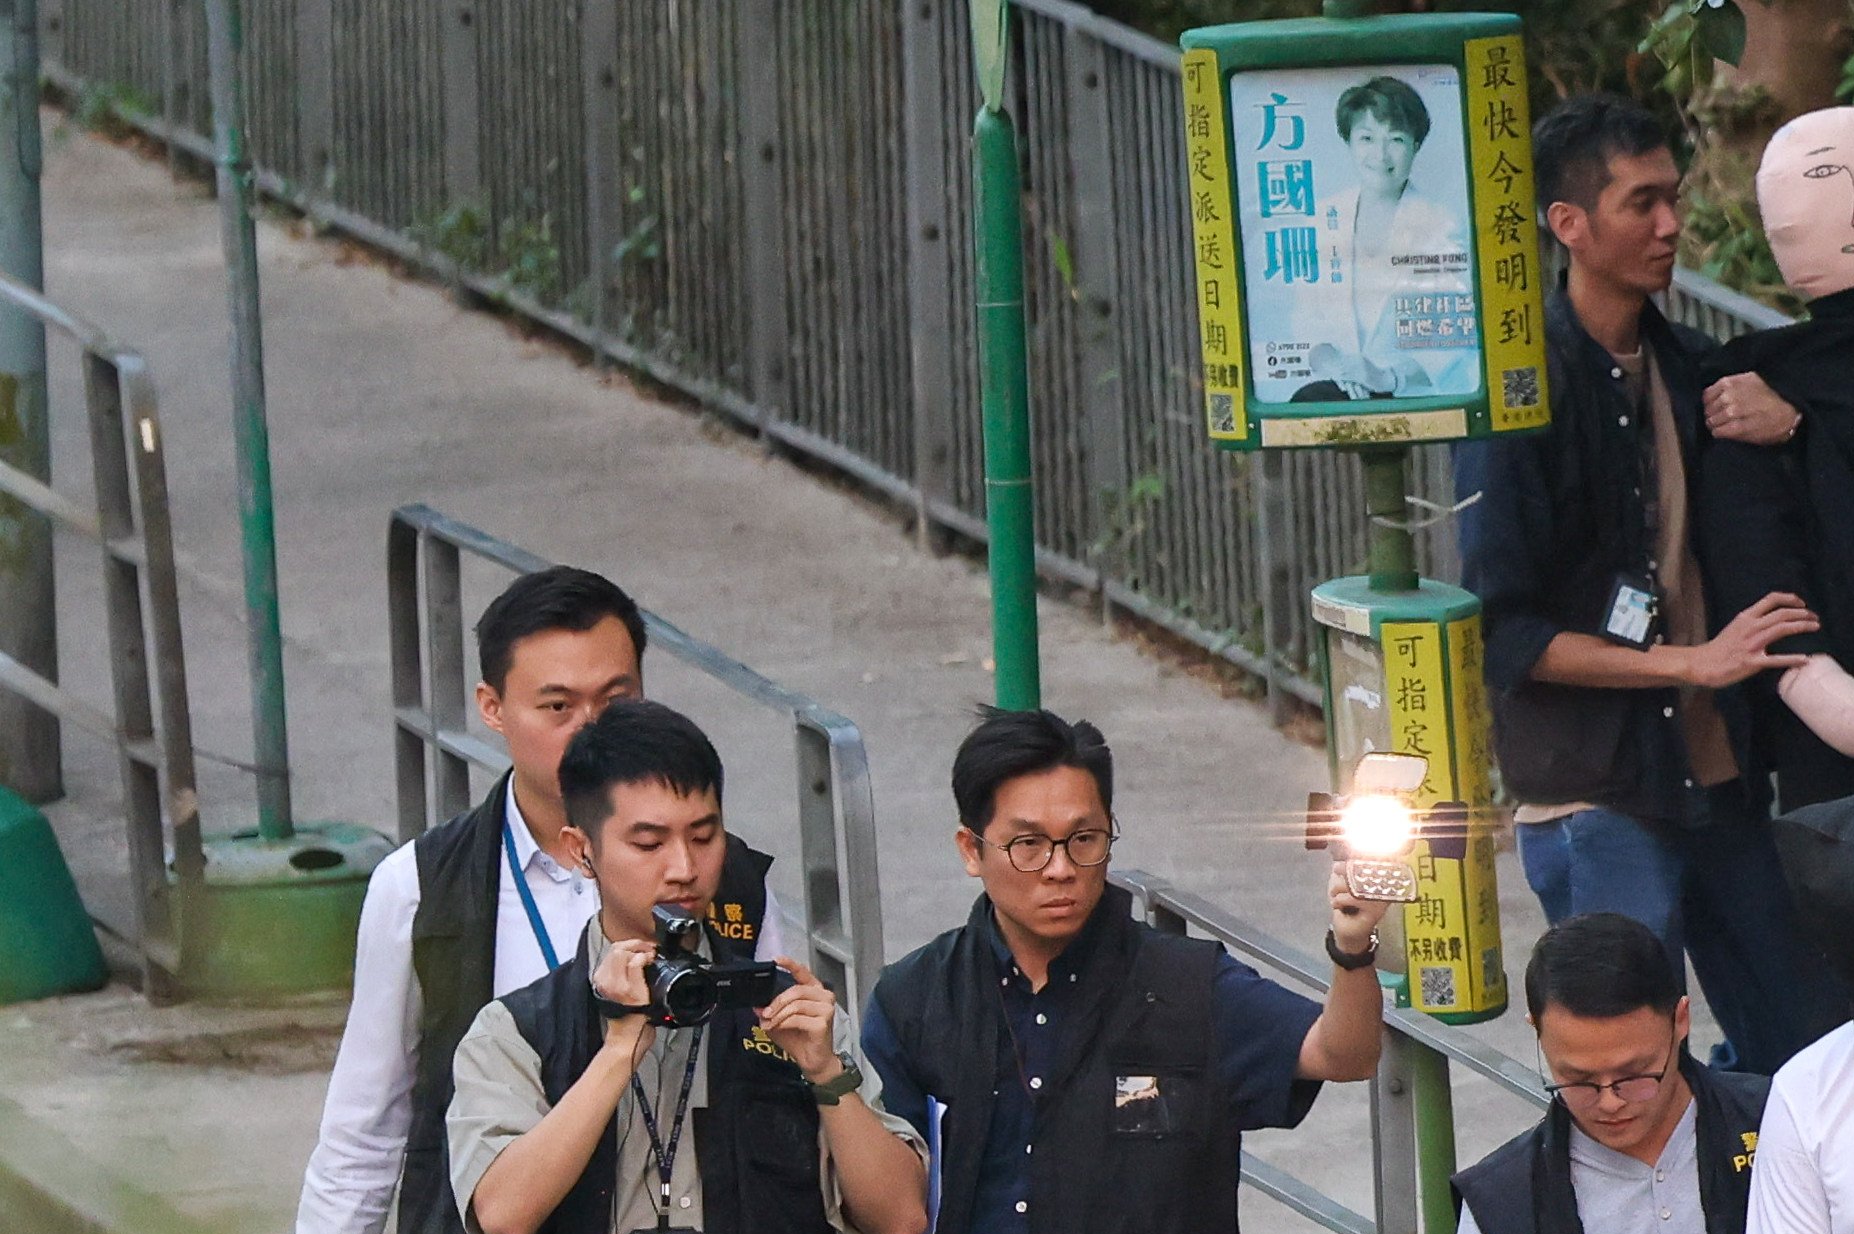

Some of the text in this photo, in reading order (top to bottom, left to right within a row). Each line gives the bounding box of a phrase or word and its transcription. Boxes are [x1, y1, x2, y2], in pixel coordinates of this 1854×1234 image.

[1185, 61, 1227, 356] 可指定派送日期
[1253, 91, 1319, 284] 方國珊
[1483, 46, 1532, 345] 最快今發明到
[1408, 936, 1462, 962] 不另收費
